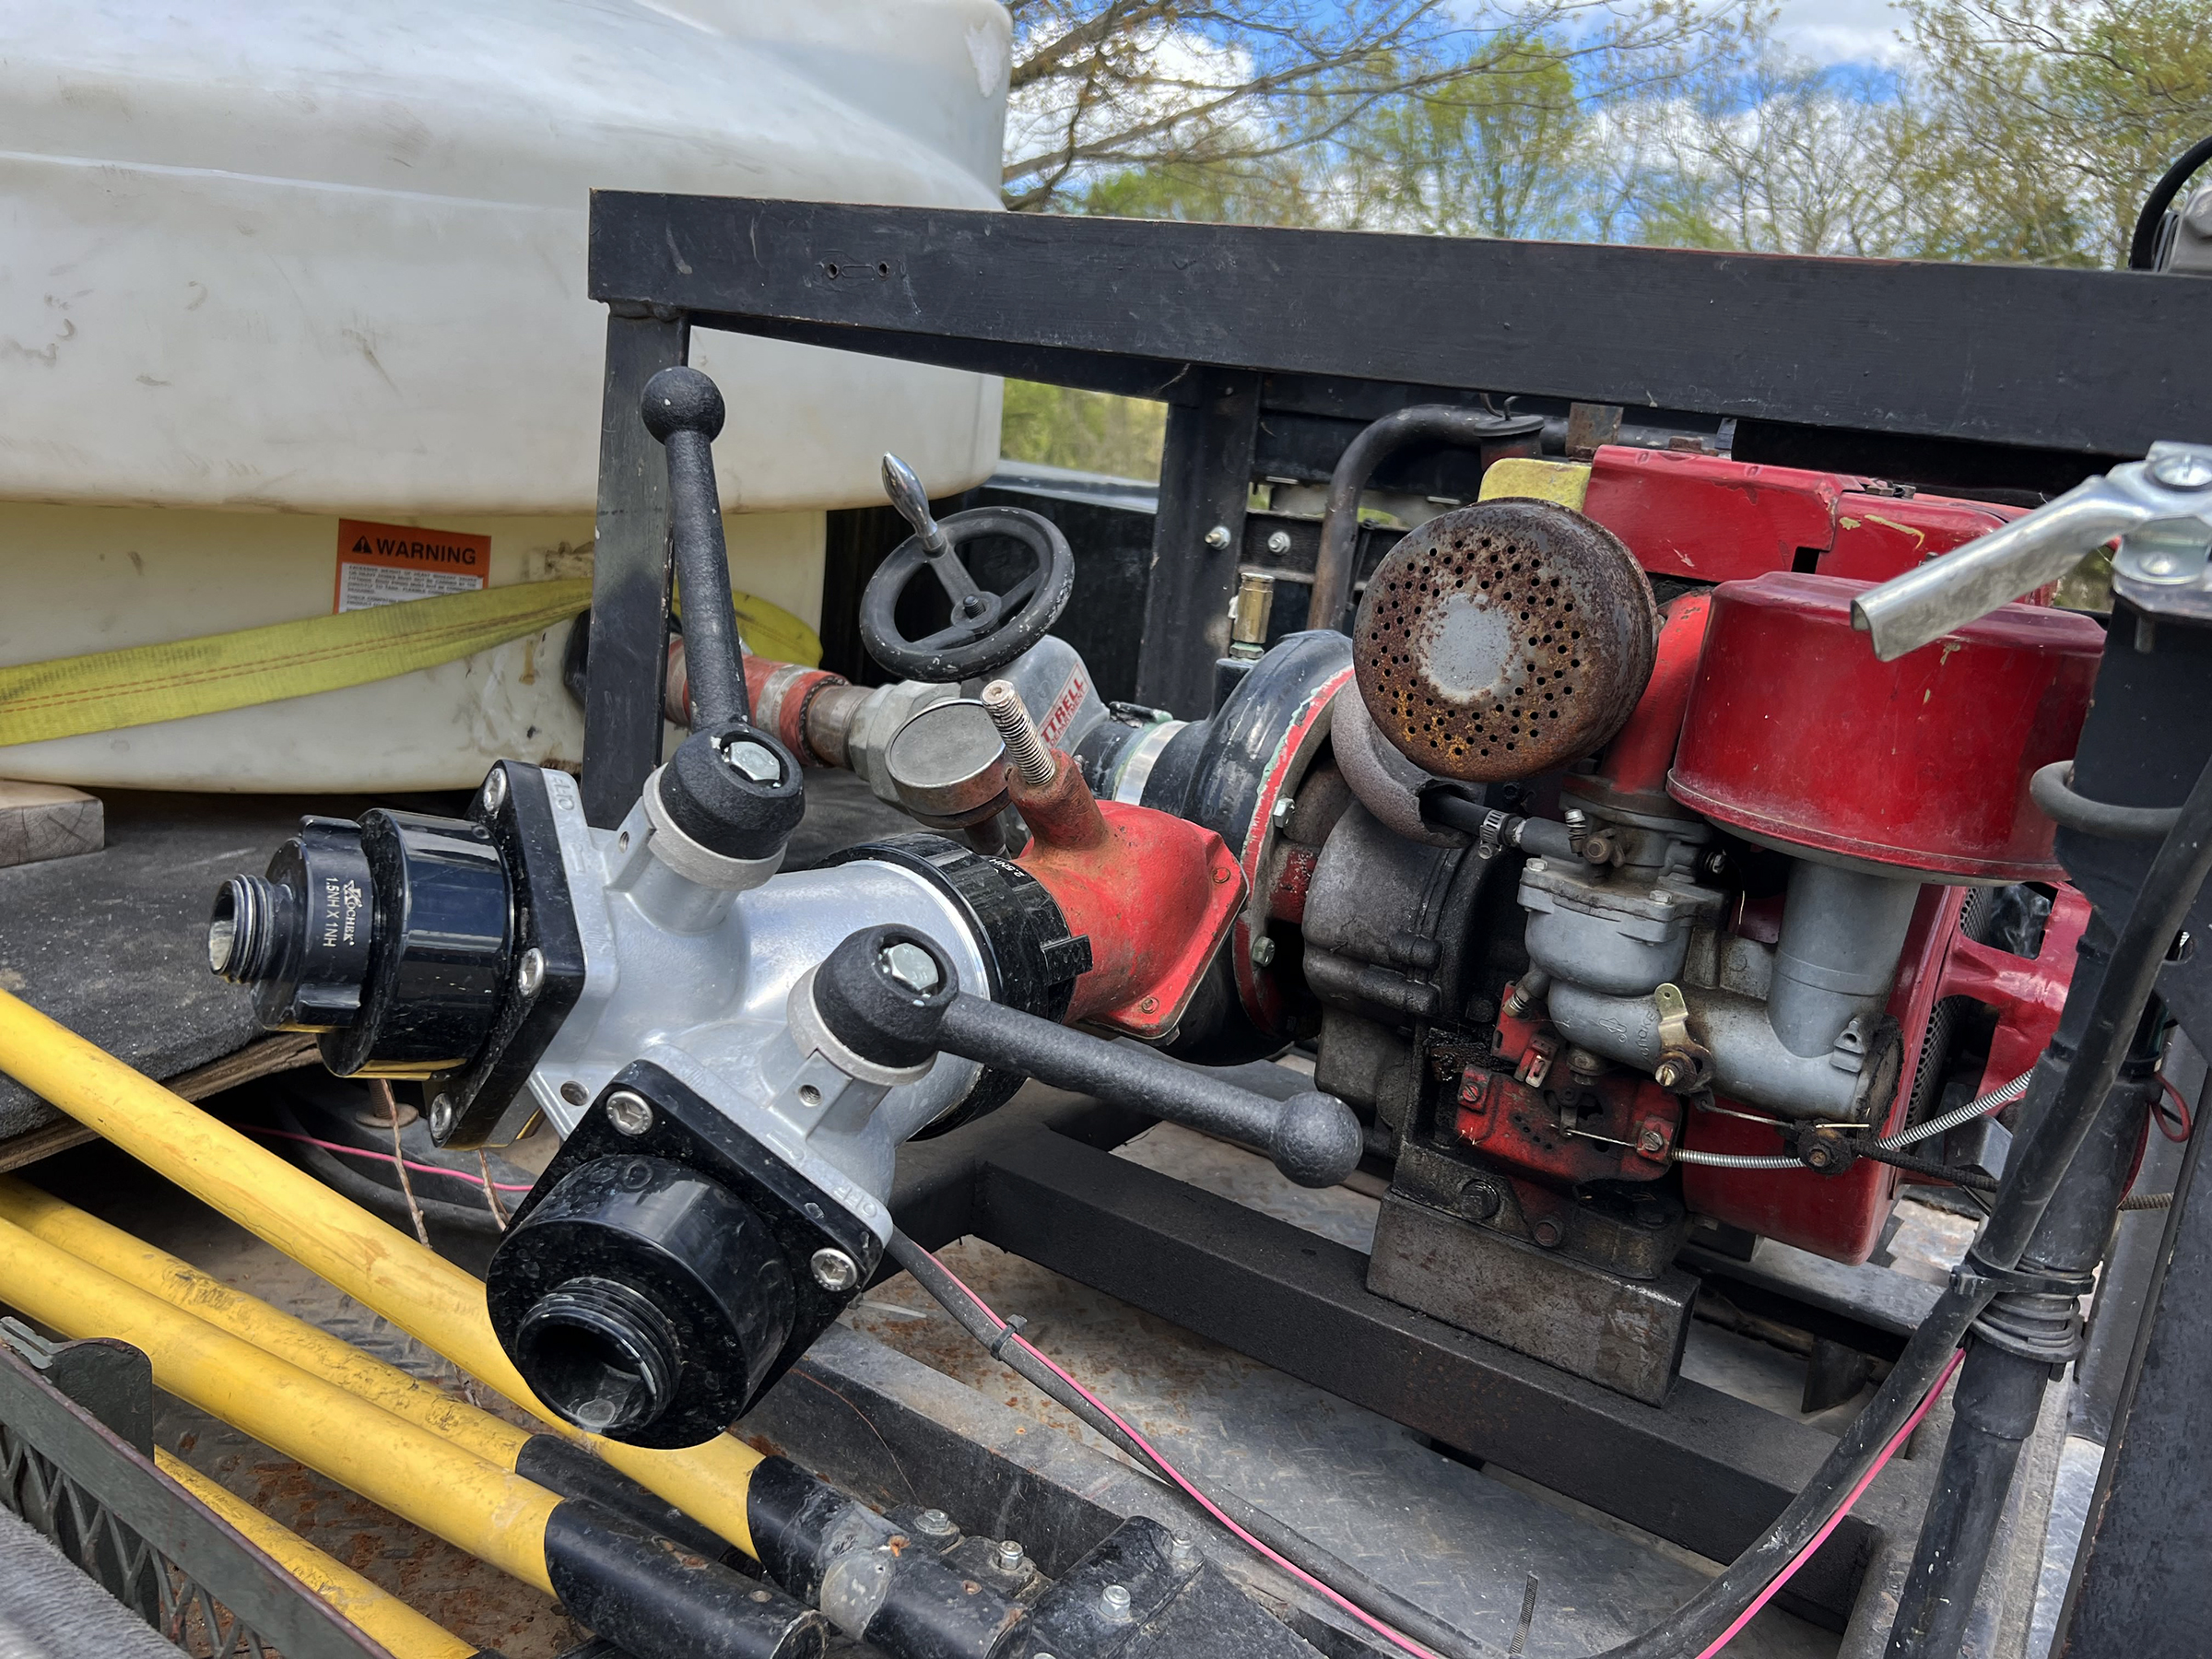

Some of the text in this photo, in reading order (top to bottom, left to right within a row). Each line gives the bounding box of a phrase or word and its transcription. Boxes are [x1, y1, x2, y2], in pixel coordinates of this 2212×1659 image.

[376, 538, 477, 566] WARNING
[1050, 688, 1087, 747] DEPARTMENT
[989, 858, 1028, 877] 2.5NH
[323, 877, 341, 947] 1.5NH X 1NH
[343, 880, 362, 942] KOCHEK
[1635, 1010, 1658, 1057] CHOKE
